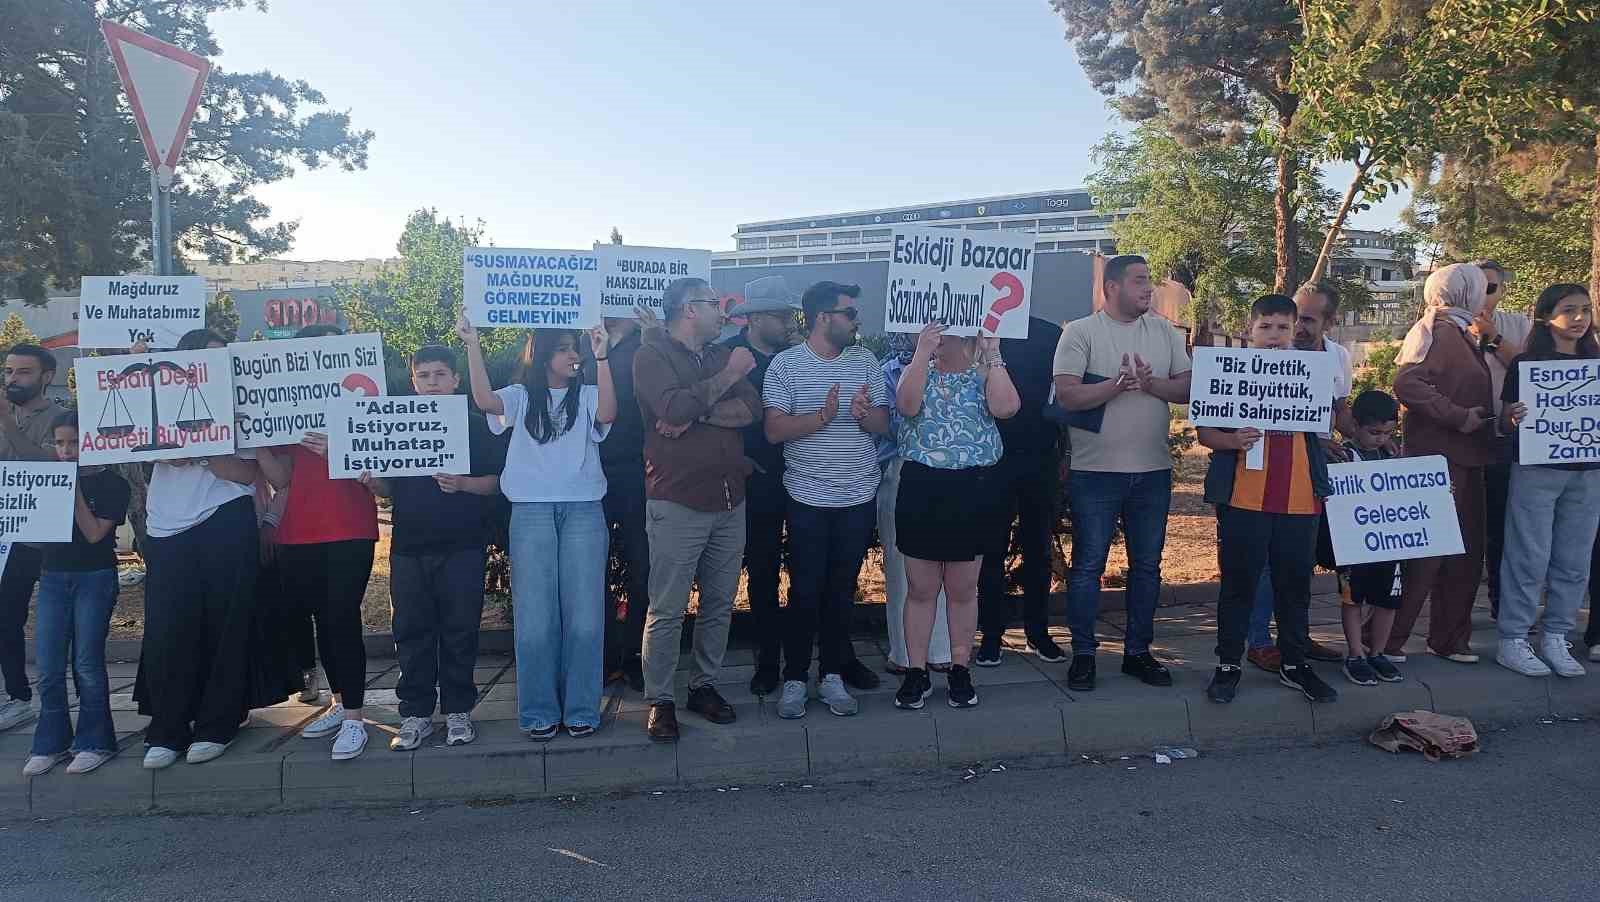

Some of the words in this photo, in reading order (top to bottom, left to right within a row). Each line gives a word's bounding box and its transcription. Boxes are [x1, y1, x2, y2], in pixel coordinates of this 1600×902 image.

[893, 234, 954, 272] Eskidji
[961, 238, 1031, 270] Bazaar
[669, 260, 688, 275] BİR
[108, 281, 179, 299] Mağduruz
[487, 271, 578, 291] MAĞDURUZ,
[606, 276, 665, 290] HAKSIZLIK
[484, 288, 581, 307] GÖRMEZDEN
[889, 278, 938, 325] Sözünde
[940, 282, 985, 328] Dursun!
[85, 304, 103, 319] Ve
[108, 304, 200, 319] Muhatabımız
[128, 328, 155, 343] Yok
[233, 352, 282, 380] Bugün
[286, 351, 309, 372] Bizi
[313, 349, 350, 370] Yarın
[355, 346, 377, 367] Sizi
[1216, 356, 1247, 374] "Biz
[1251, 354, 1311, 380] Ürettik,
[1529, 365, 1588, 382] Esnaf
[237, 382, 342, 408] Dayanışmaya
[1209, 378, 1233, 396] Biz
[1238, 379, 1313, 402] Büyüttük,
[356, 400, 438, 415] "Adalet
[1191, 399, 1234, 421] Şimdi
[1239, 402, 1330, 424] Sahipsiziz!"
[239, 410, 326, 440] Çağırıyoruz
[348, 416, 448, 436] İstiyoruz,
[352, 437, 445, 452] Muhatap
[1549, 444, 1600, 459] Zam
[344, 453, 455, 472] İstiyoruz!"
[2, 466, 73, 491] İstiyoruz,
[1370, 471, 1448, 492] Olmazsa
[1354, 501, 1431, 526] Gelecek
[1365, 528, 1430, 552] Olmaz!
